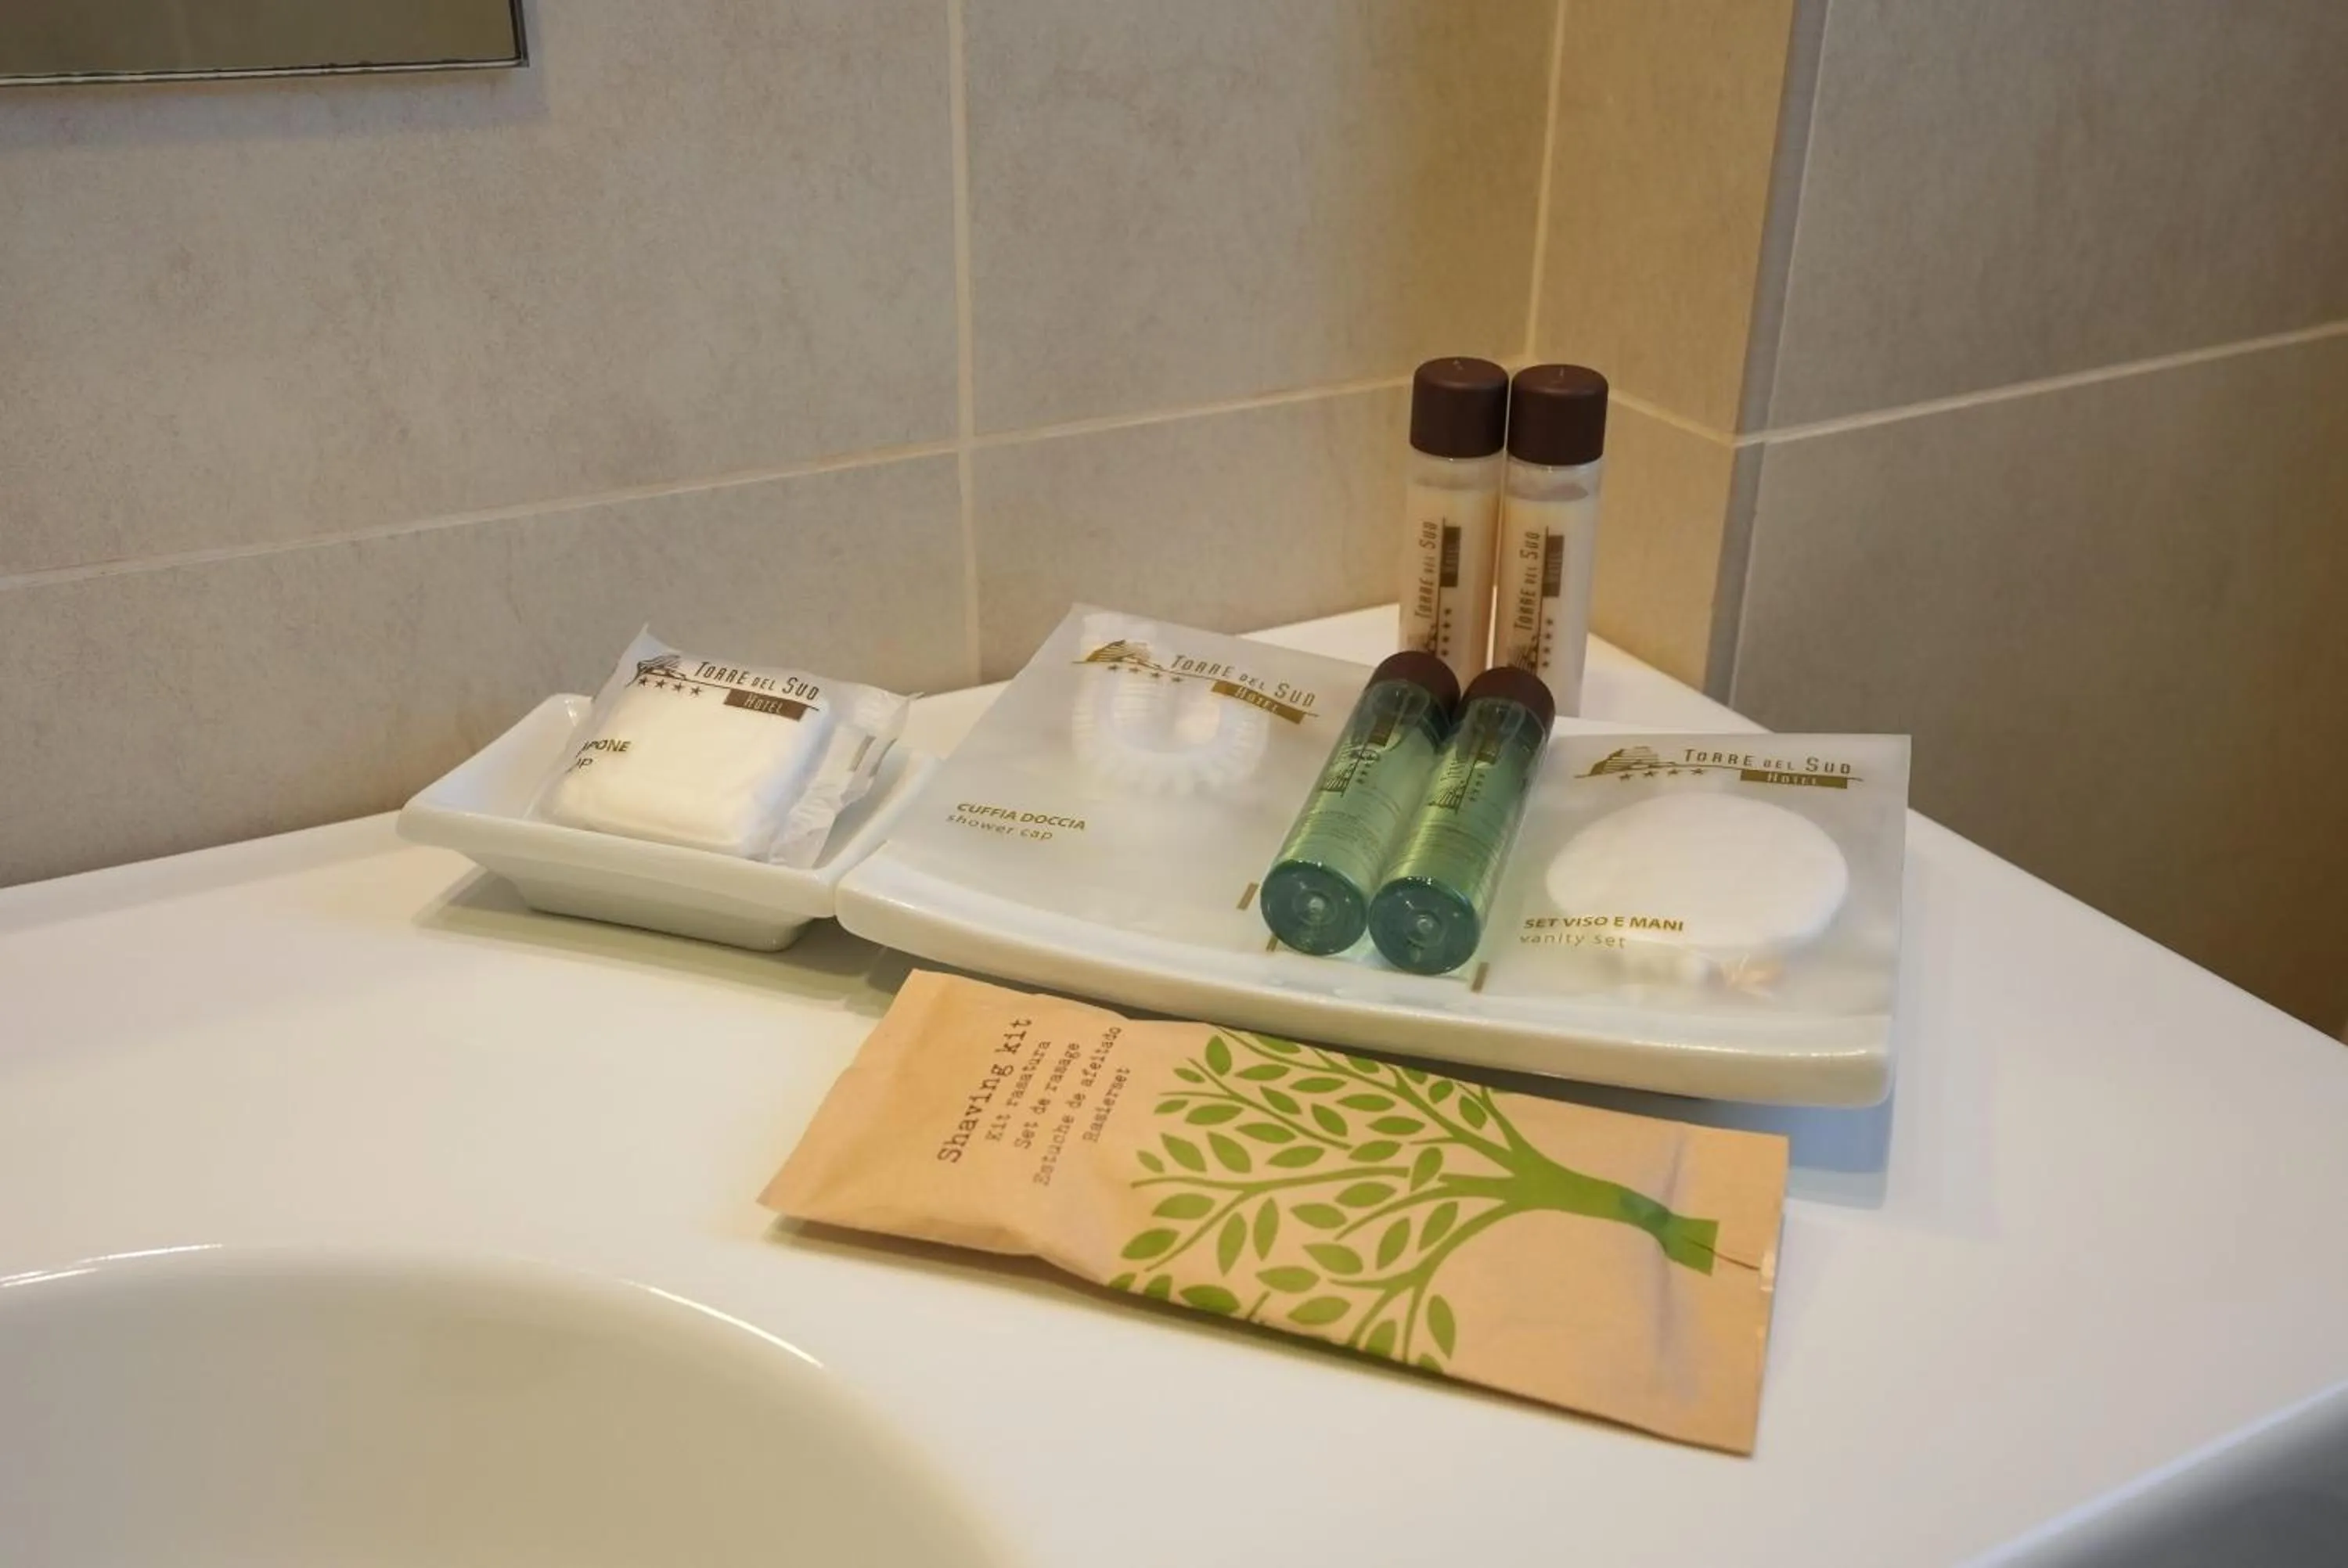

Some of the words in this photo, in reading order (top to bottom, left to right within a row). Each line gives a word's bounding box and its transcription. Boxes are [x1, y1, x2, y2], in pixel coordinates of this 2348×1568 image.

[694, 662, 750, 685] TORRE
[1684, 749, 1754, 767] TORRE
[947, 814, 1014, 835] shower
[1020, 829, 1053, 841] cap
[957, 803, 1017, 821] CUFFIA
[1020, 813, 1086, 830] DOCCIA
[1523, 917, 1559, 929] SET
[1563, 916, 1608, 927] VISO
[1614, 916, 1626, 927] E
[1629, 916, 1684, 931] MANI
[1519, 932, 1584, 947] vanity
[1593, 934, 1627, 948] set
[937, 1064, 1014, 1163] Shaving
[995, 1018, 1032, 1055] kit
[986, 1114, 1010, 1142] Kit
[1007, 1041, 1051, 1107] rasatura
[1014, 1122, 1038, 1149] Set
[1030, 1097, 1051, 1114] de
[1045, 1042, 1081, 1092] rasage
[1033, 1114, 1075, 1186] Estuche
[1066, 1093, 1086, 1109] de
[1081, 1027, 1122, 1088] afeitado
[1082, 1067, 1130, 1143] Rasierset
